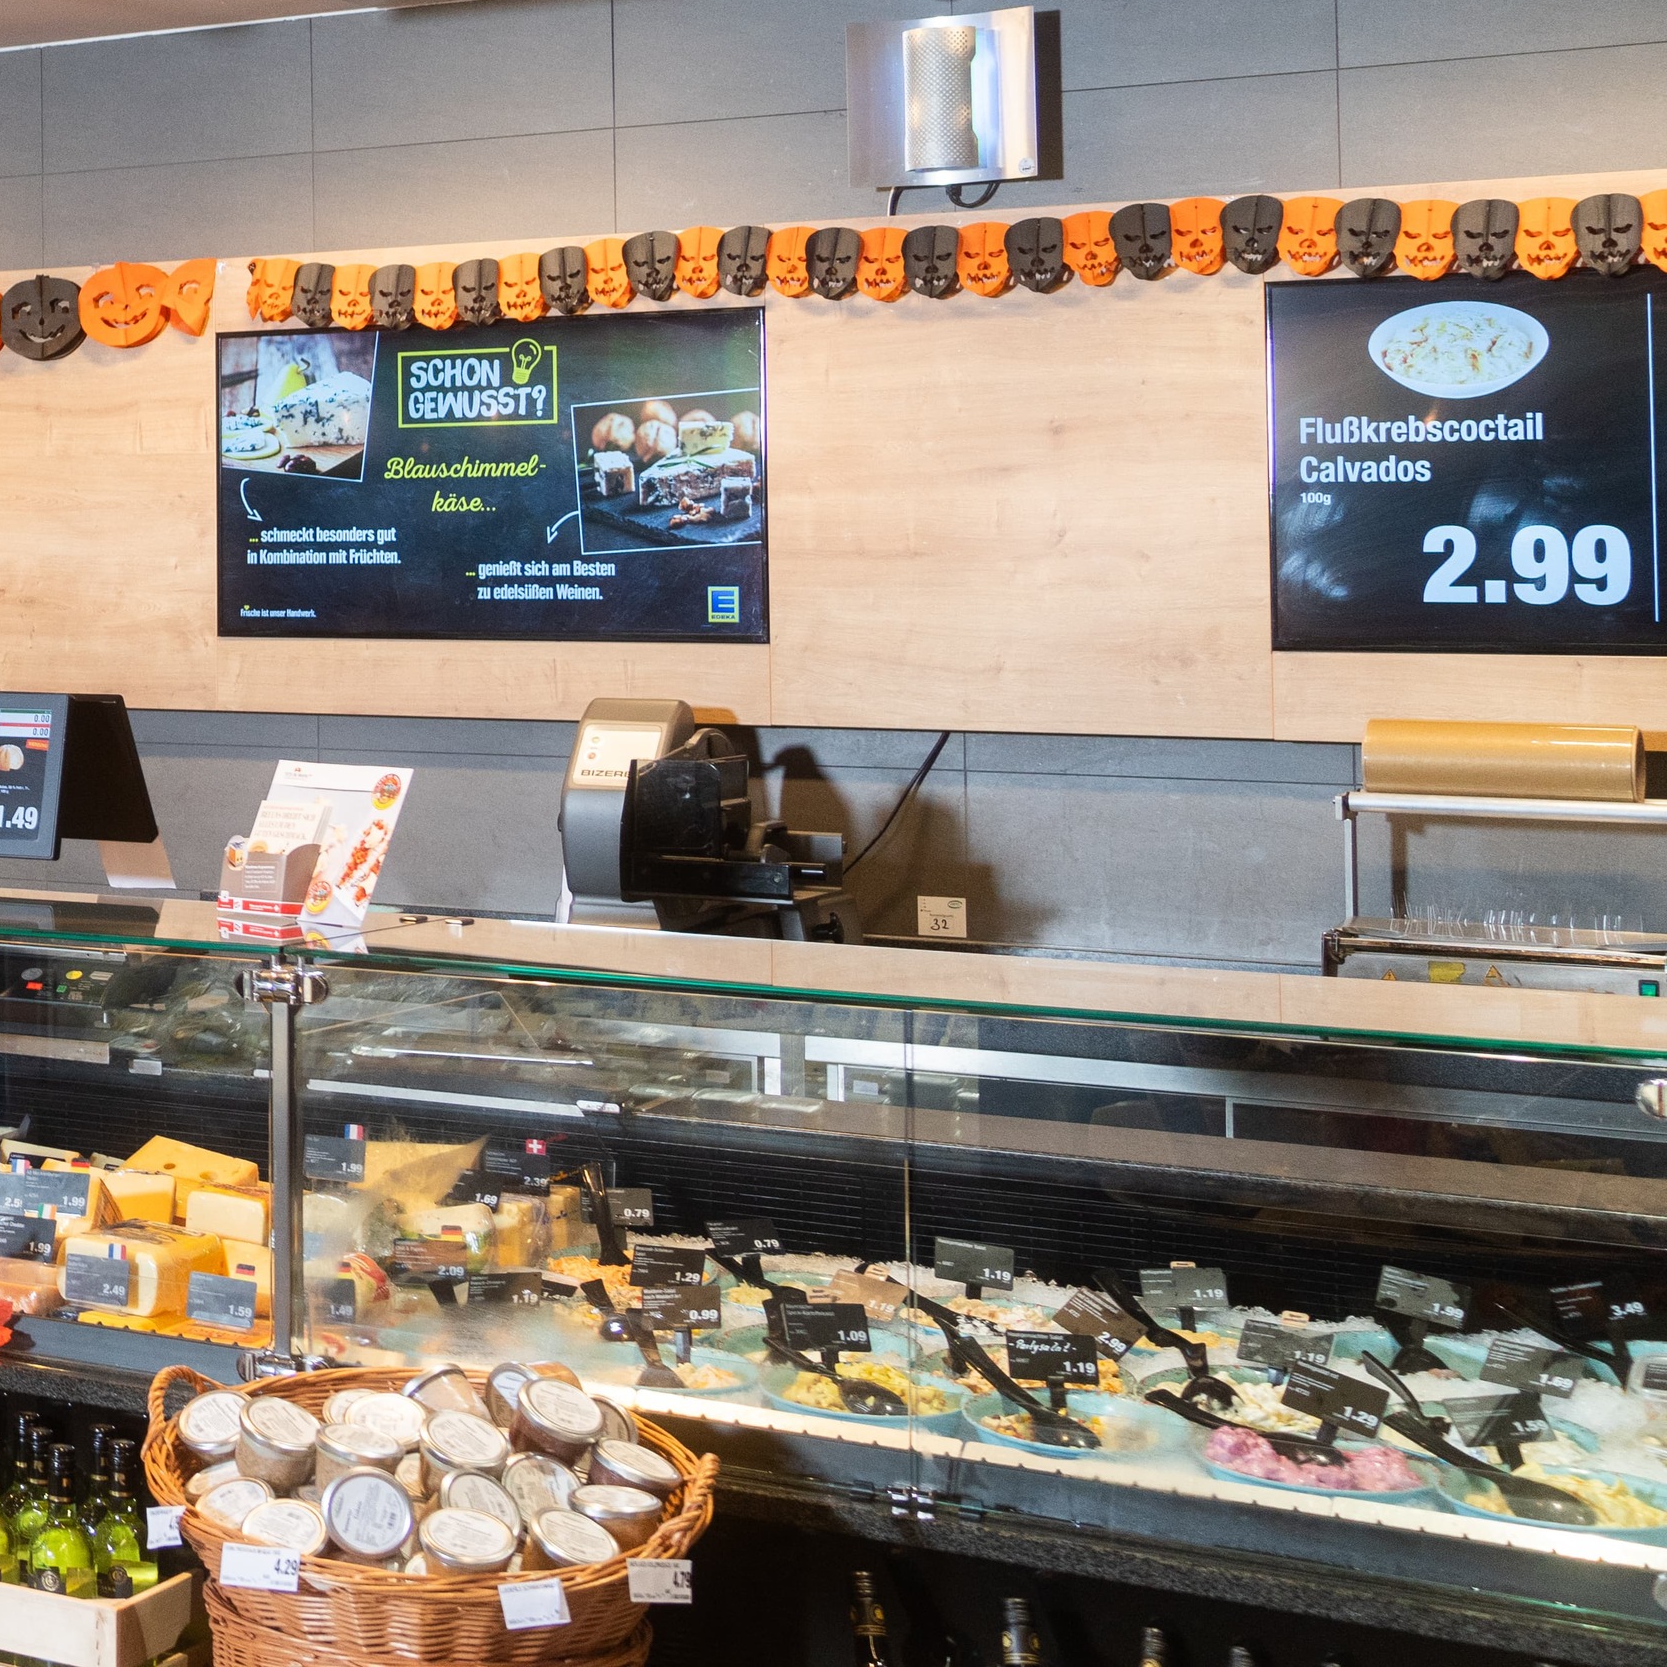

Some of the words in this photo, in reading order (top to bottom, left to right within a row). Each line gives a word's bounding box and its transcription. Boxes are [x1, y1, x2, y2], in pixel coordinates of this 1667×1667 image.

[409, 356, 501, 392] SCHON
[407, 384, 547, 421] GEWUSST?
[1300, 412, 1544, 444] Flußkrebscoctail
[384, 454, 547, 482] Blauschimmel-
[1300, 455, 1432, 483] Calvados
[431, 489, 498, 515] käse...
[1300, 492, 1332, 506] 100g
[260, 527, 314, 543] schmeckt
[316, 526, 375, 543] besonders
[376, 527, 397, 545] gut
[247, 549, 258, 565] in
[259, 549, 327, 565] Kombination
[328, 549, 348, 564] mit
[349, 548, 402, 564] Früchten.
[478, 560, 521, 581] genießt
[523, 560, 549, 577] sich
[552, 564, 571, 577] am
[572, 560, 616, 577] Besten
[1422, 524, 1632, 606] 2.99
[477, 587, 492, 601] zu
[493, 583, 553, 601] edelsüßen
[555, 582, 604, 600] Weinen.
[240, 608, 261, 617] Frische
[261, 608, 269, 617] ist
[270, 610, 286, 618] unser
[287, 608, 317, 618] Handwerk.
[34, 714, 50, 723] 0.00
[32, 728, 49, 736] 0.00
[341, 1162, 363, 1174] 1.99
[523, 1176, 547, 1188] 2.39
[62, 1195, 86, 1207] 1.99
[474, 1193, 497, 1205] 1.69
[623, 1208, 650, 1218] 0.79
[28, 1241, 51, 1254] 1.99
[754, 1239, 780, 1249] 0.79
[437, 1265, 464, 1277] 2.09
[674, 1271, 701, 1283] 1.29
[982, 1267, 1011, 1281] 1.19
[102, 1284, 126, 1296] 2.49
[1193, 1288, 1224, 1298] 1.19
[228, 1304, 252, 1318] 1.59
[868, 1299, 896, 1313] 1.19
[1431, 1303, 1465, 1320] 1.99
[1610, 1302, 1645, 1317] 3.49
[689, 1308, 719, 1320] 0.99
[837, 1330, 867, 1342] 1.09
[1097, 1332, 1127, 1352] 2.99
[1293, 1350, 1326, 1364] 1.19
[1063, 1361, 1096, 1374] 1.19
[1538, 1373, 1573, 1390] 1.69
[1343, 1406, 1379, 1429] 1.29
[1513, 1420, 1548, 1433] 1.59
[273, 1558, 298, 1576] 4.29
